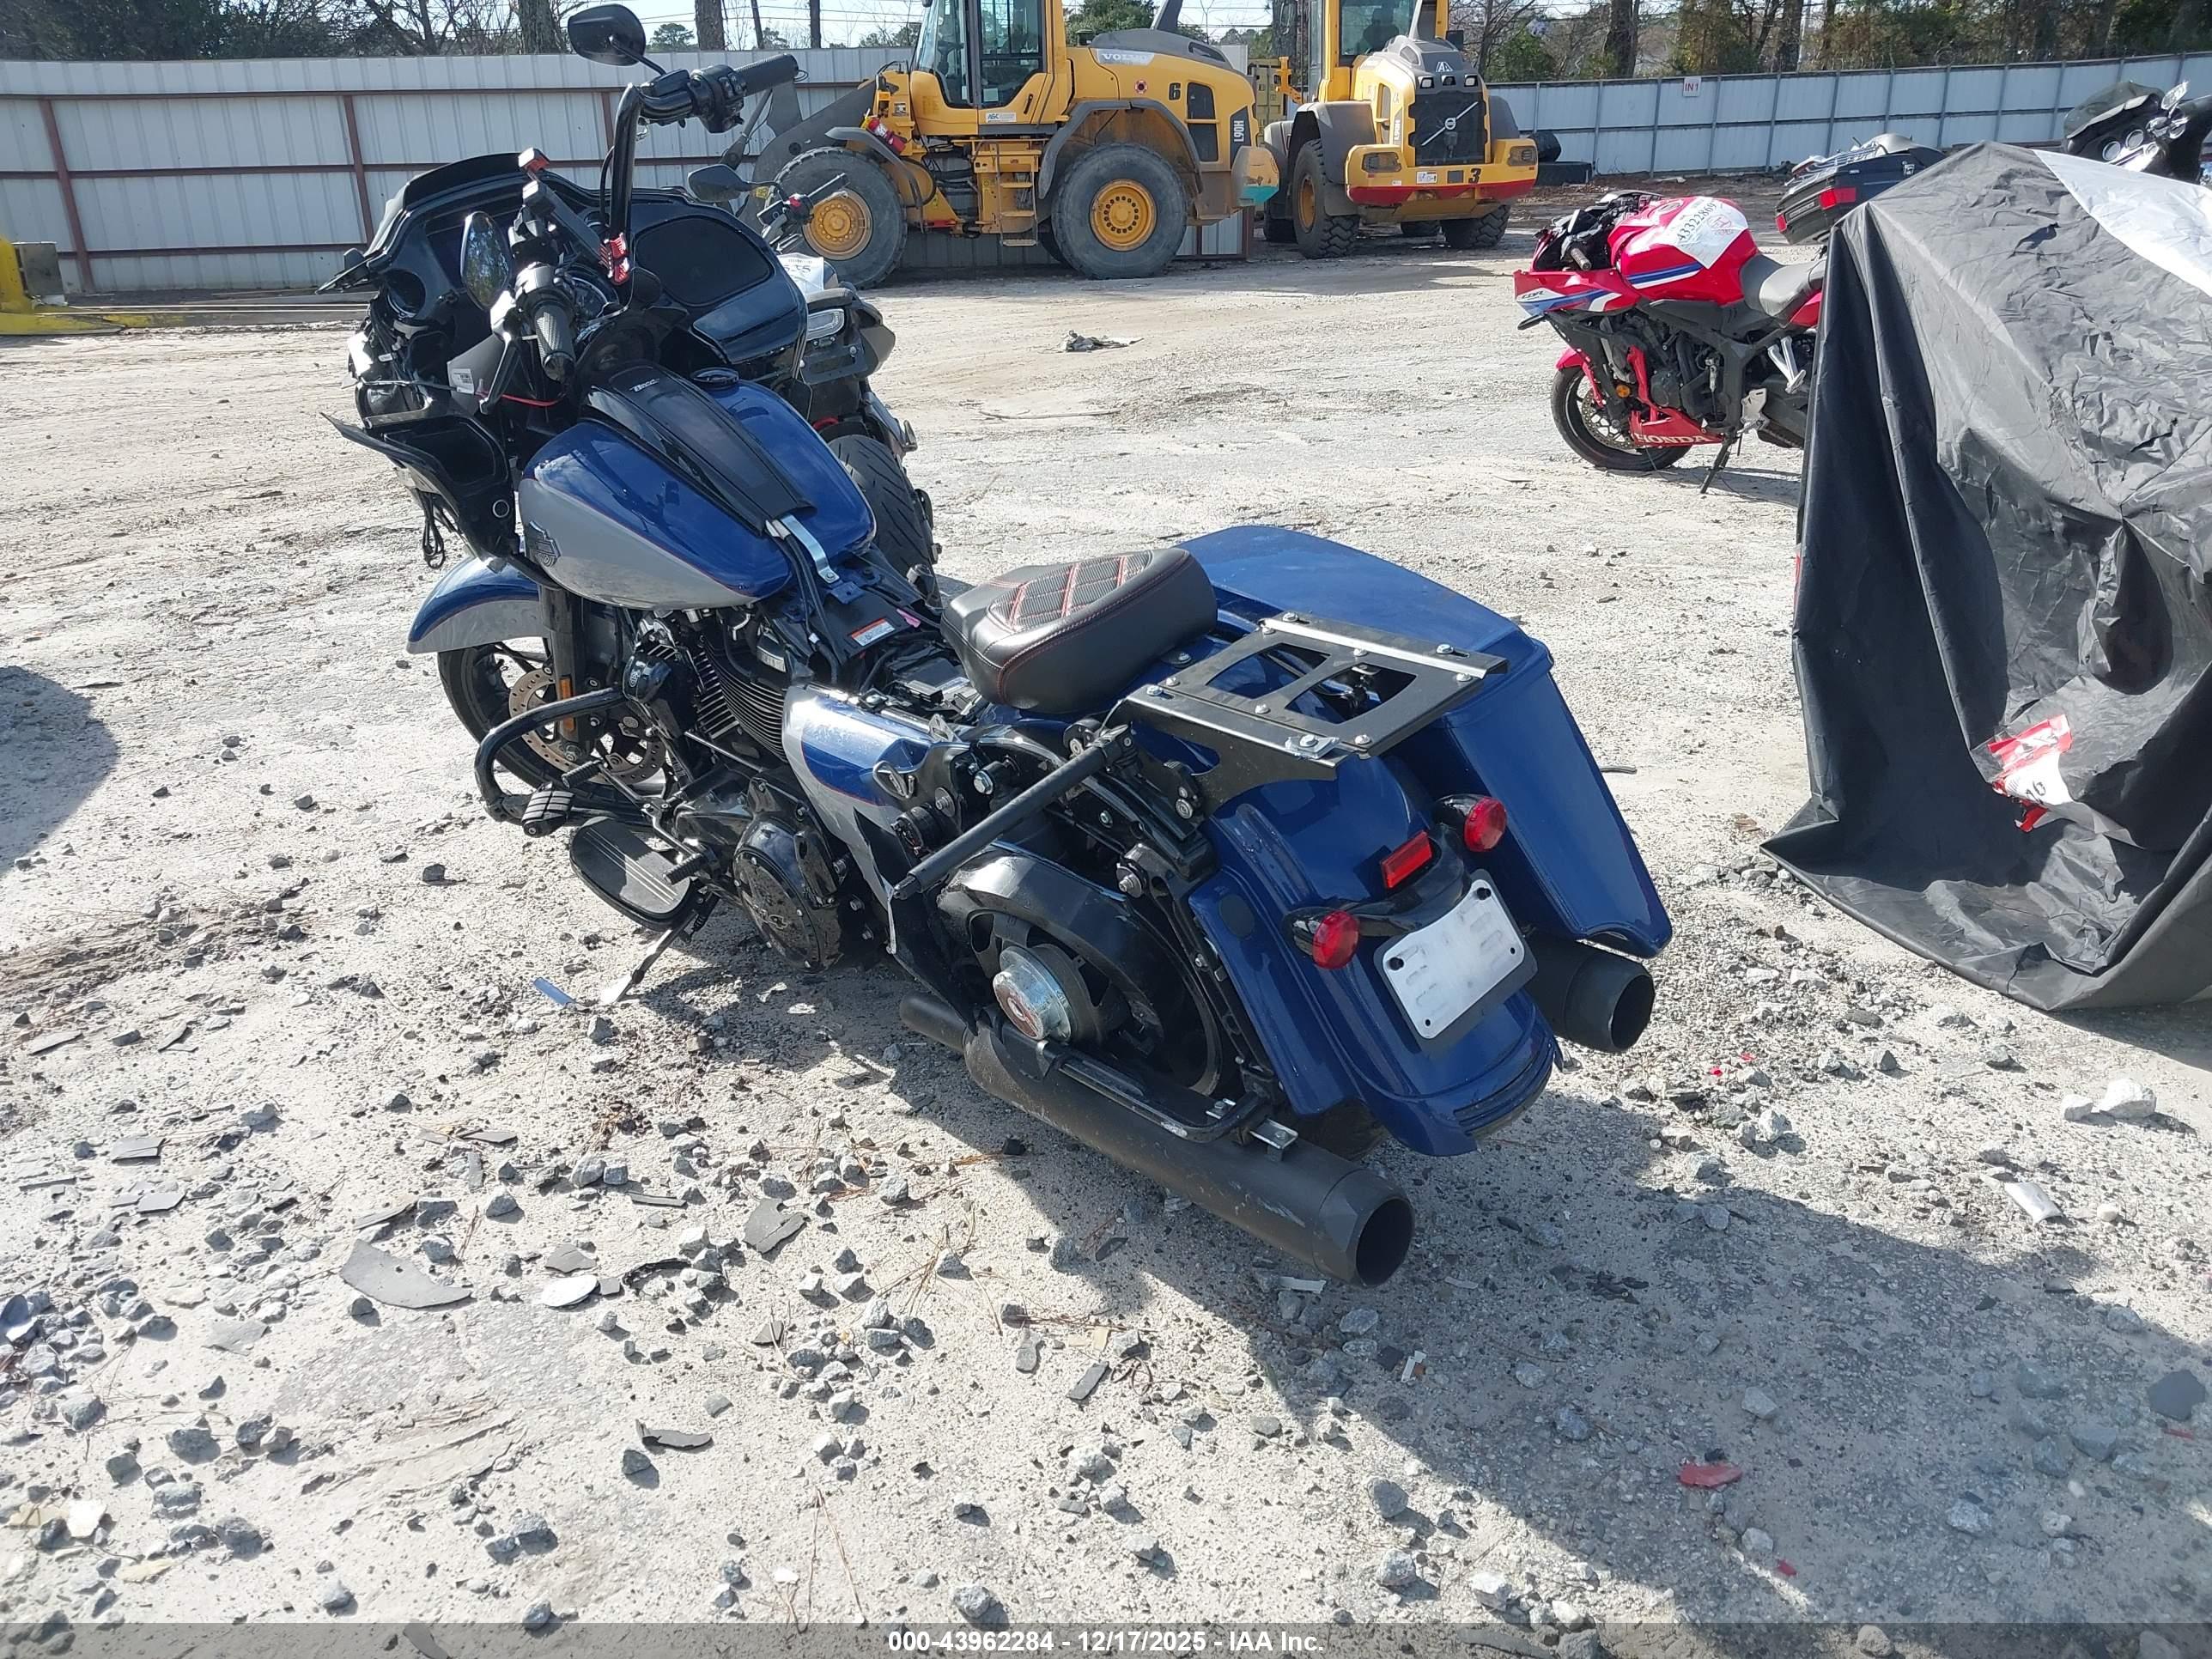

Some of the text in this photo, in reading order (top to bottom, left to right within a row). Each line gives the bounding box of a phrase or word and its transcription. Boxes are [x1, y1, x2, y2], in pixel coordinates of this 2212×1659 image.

[1169, 82, 1182, 100] 6
[1686, 82, 1693, 91] IN
[1234, 120, 1244, 142] L90H
[1468, 168, 1481, 184] 3
[1632, 432, 1714, 443] HONDA
